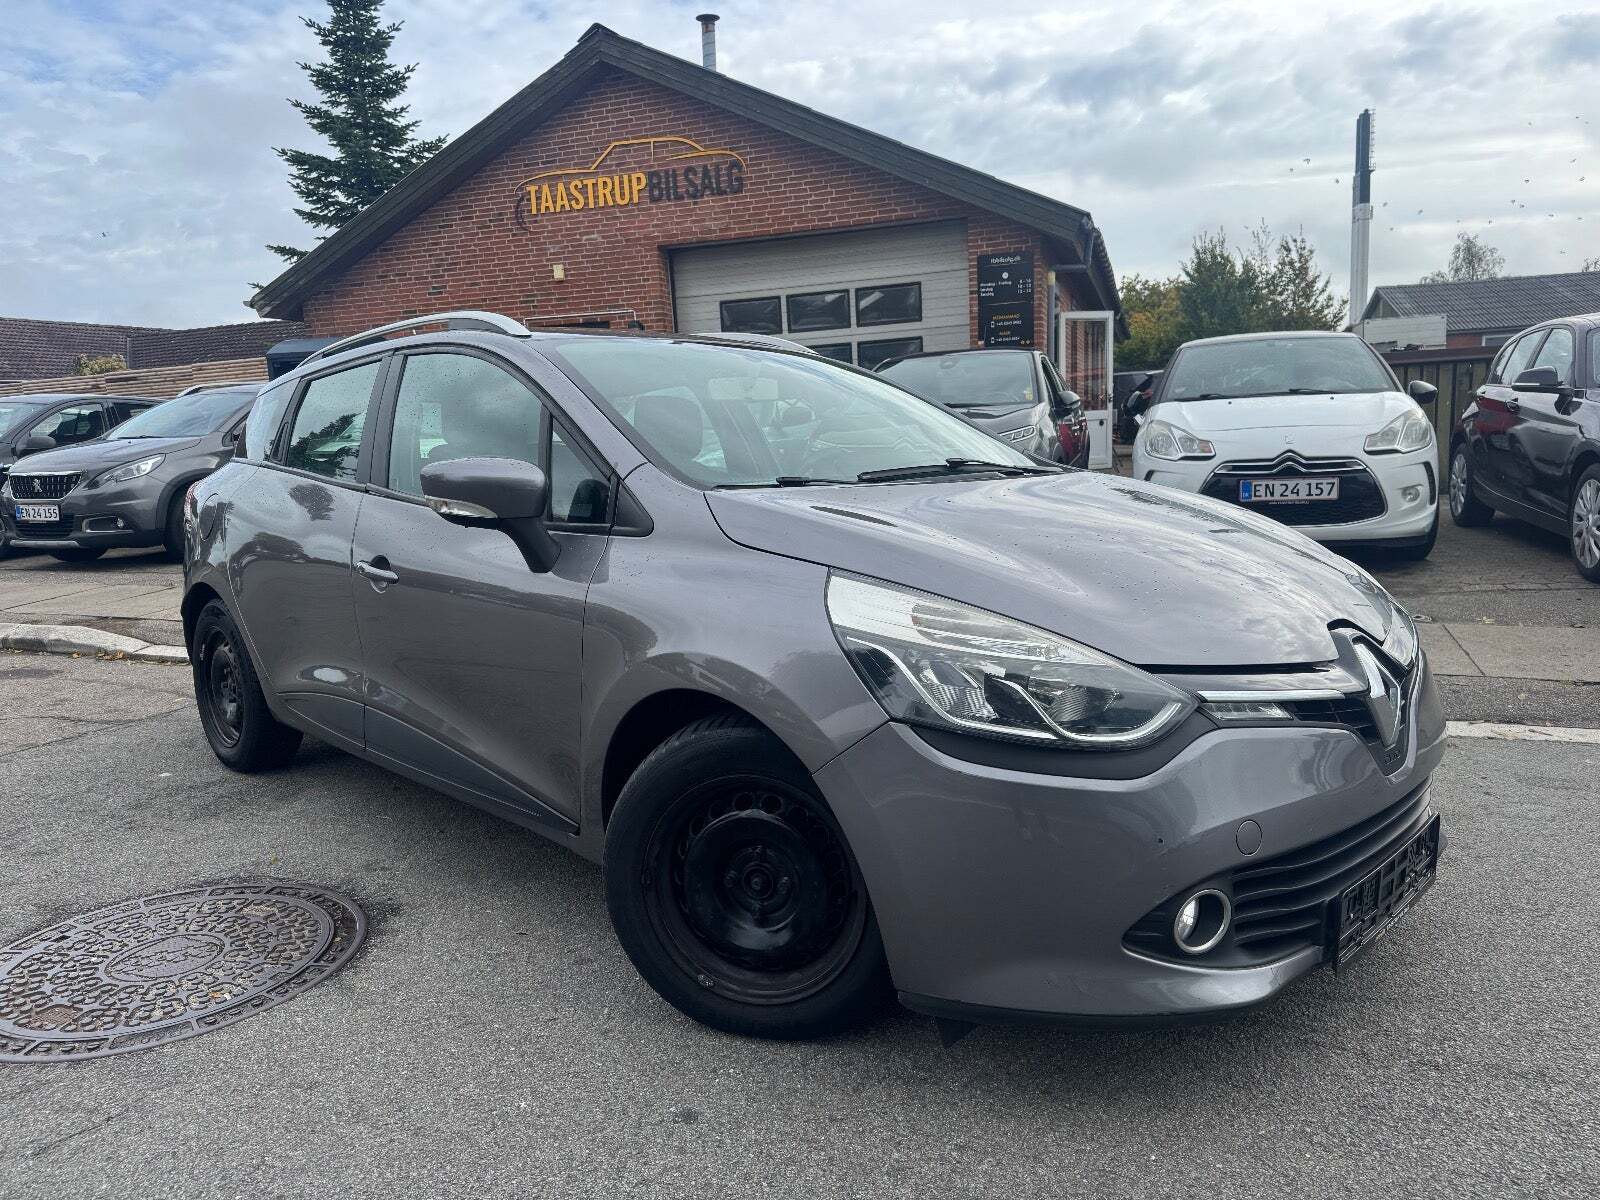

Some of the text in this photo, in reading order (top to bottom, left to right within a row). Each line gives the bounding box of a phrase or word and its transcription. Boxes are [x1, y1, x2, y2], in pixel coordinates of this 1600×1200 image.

[1253, 482, 1336, 498] EN 24 157
[20, 507, 58, 519] EN 24 155
